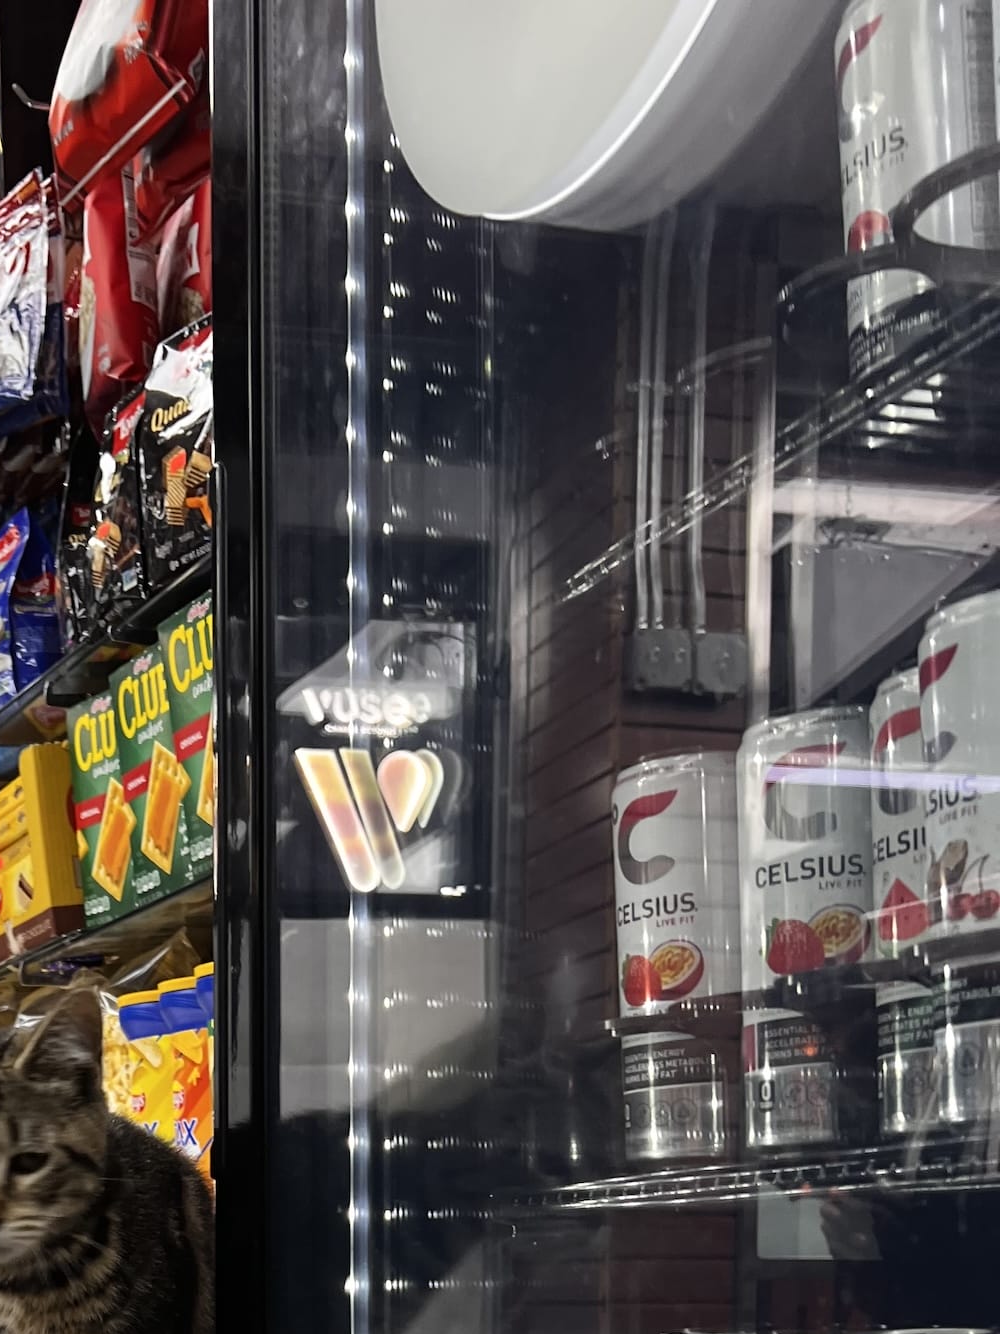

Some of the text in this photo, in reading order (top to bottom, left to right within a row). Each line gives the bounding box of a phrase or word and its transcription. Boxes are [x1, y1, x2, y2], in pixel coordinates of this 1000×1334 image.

[843, 127, 905, 187] LSIUS
[169, 613, 213, 693] CLU
[74, 709, 117, 772] CLU
[924, 776, 977, 818] LSIUS
[656, 915, 695, 927] LIVE FIT
